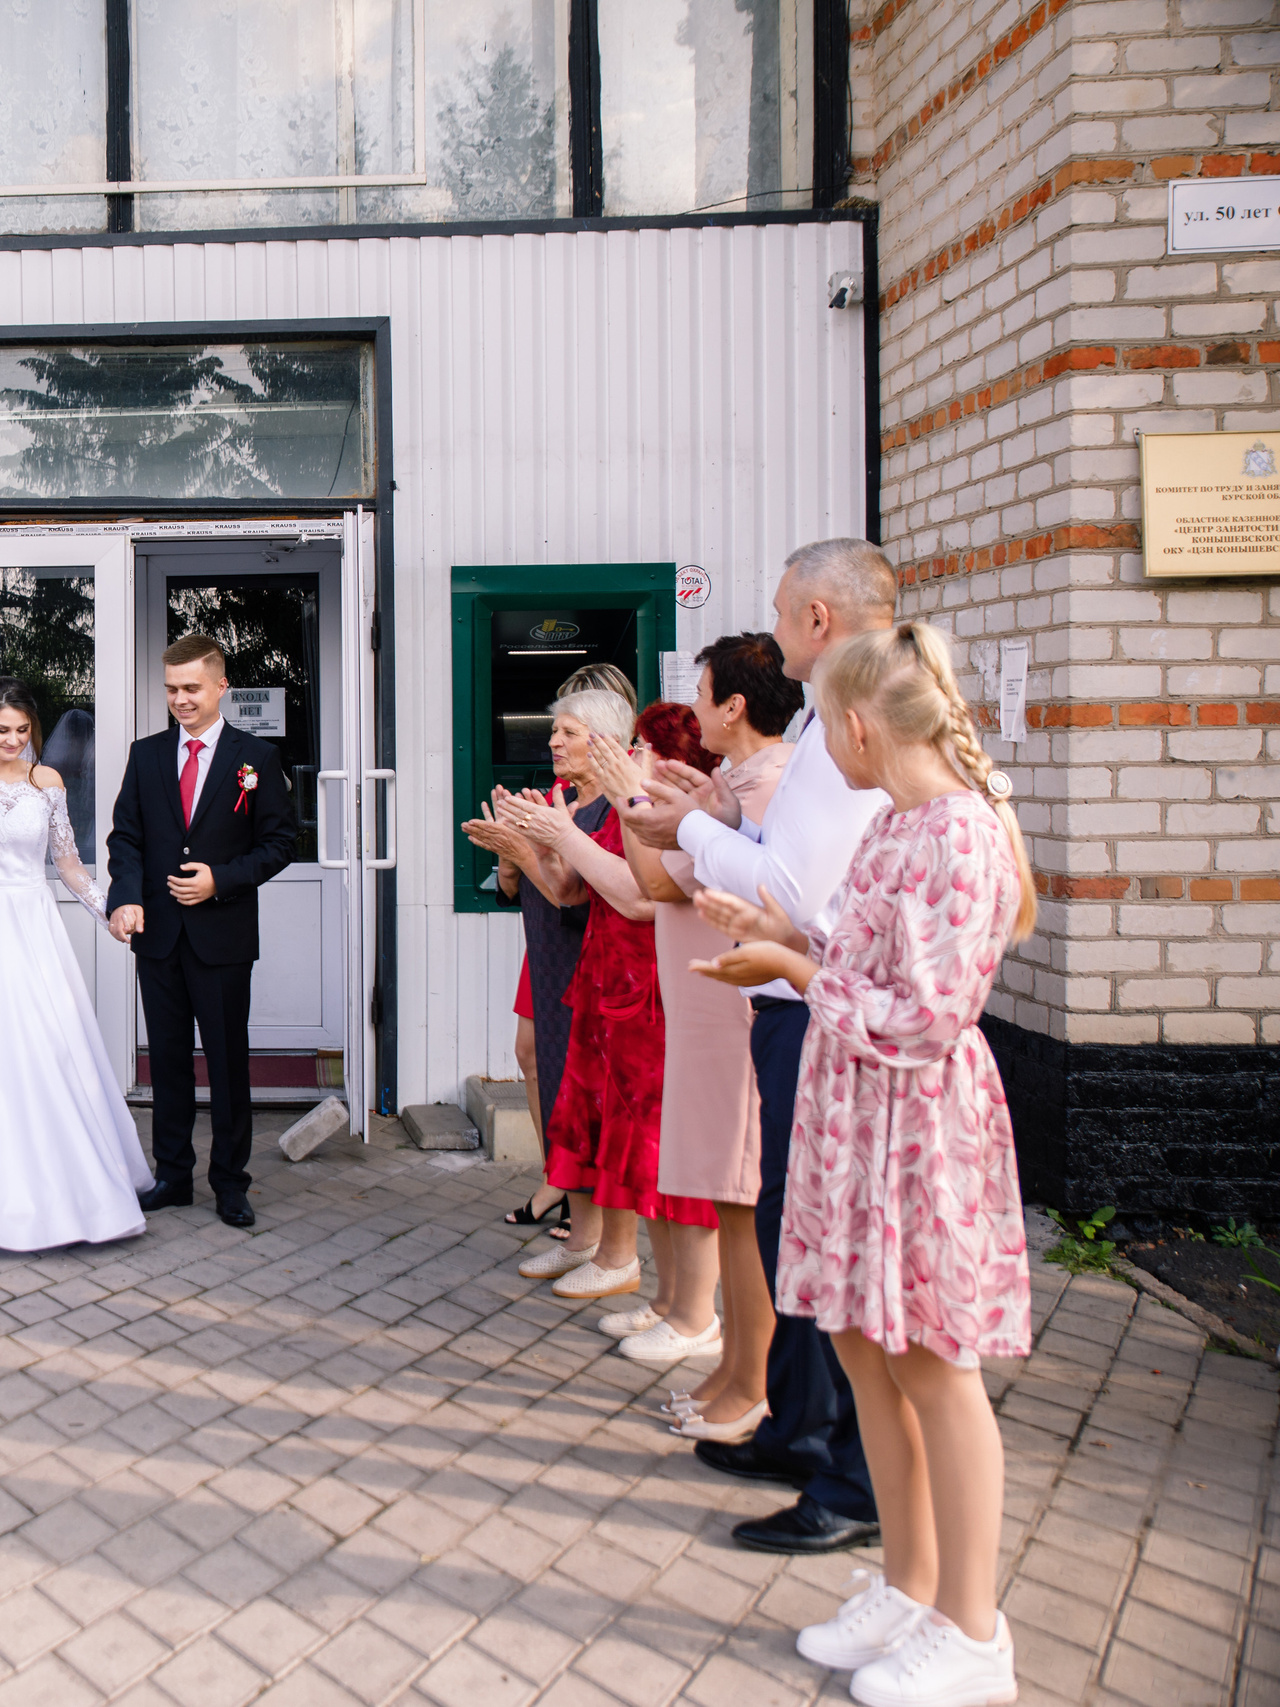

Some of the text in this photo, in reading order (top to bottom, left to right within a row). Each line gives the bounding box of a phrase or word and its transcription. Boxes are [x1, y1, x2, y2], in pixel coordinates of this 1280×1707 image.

[1184, 211, 1209, 226] ул.
[1215, 206, 1235, 220] 50
[1241, 208, 1272, 219] лет
[1155, 486, 1198, 494] КОМИТЕТ
[1215, 485, 1244, 493] ТРУДУ
[1222, 493, 1265, 501] КУРСКОЙ
[1175, 515, 1280, 524] ОБЛАСТНОЕ КАЗЕННОЕ
[1174, 524, 1279, 535] «ЦЕНТР ЗАНЯТОСТИ
[1191, 535, 1280, 544] КОНЫШЕВСКОГО
[1163, 547, 1184, 555] ОКУ
[681, 577, 703, 585] TOTAL
[232, 693, 269, 702] ВХОДА
[240, 706, 261, 715] НЕТ
